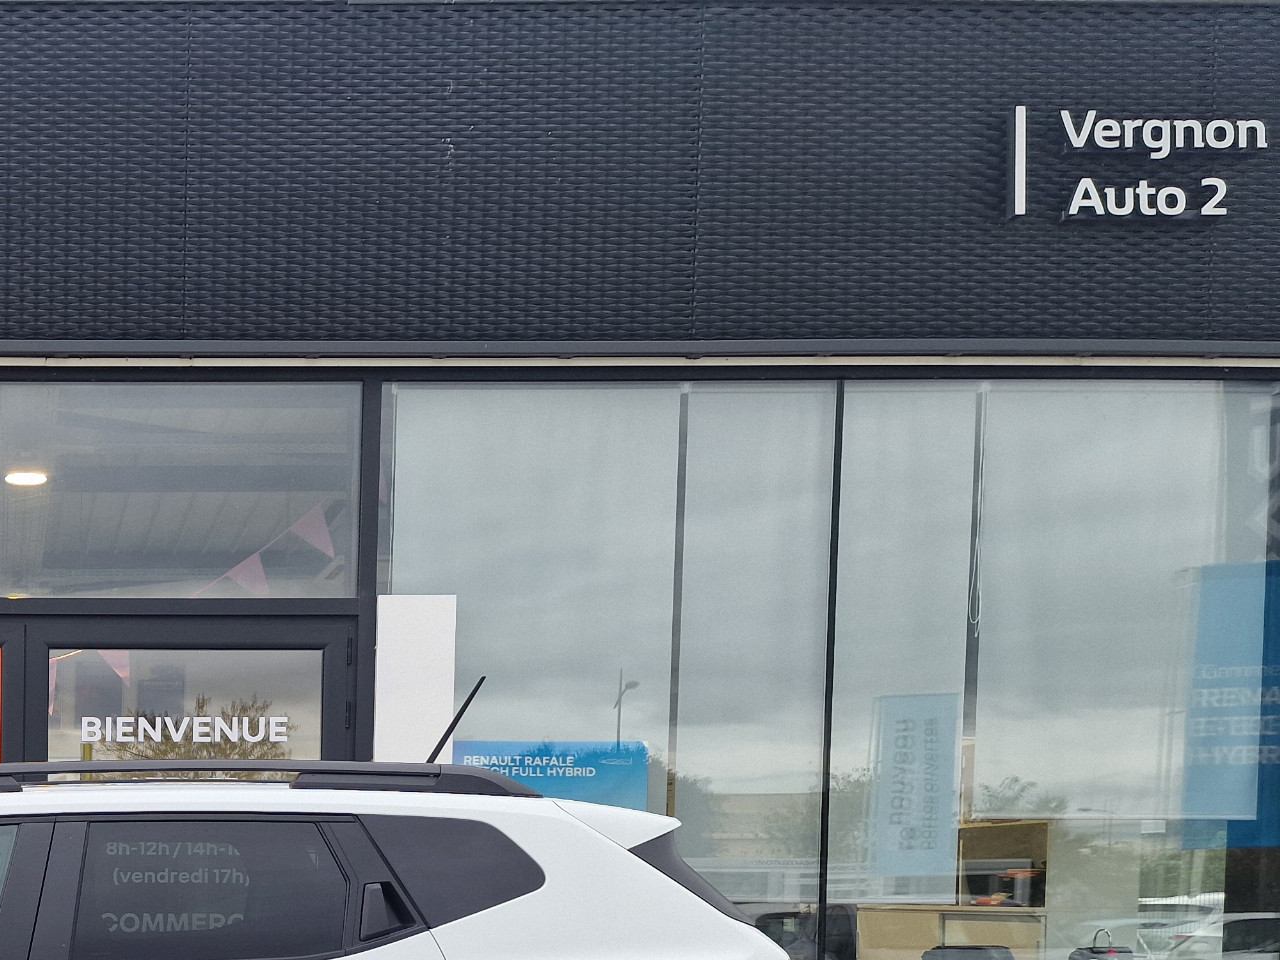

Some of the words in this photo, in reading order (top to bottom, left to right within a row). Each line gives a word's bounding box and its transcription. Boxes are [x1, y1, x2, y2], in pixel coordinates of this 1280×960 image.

[1060, 110, 1268, 160] Vergnon
[1069, 177, 1186, 216] Auto
[1200, 177, 1227, 216] 2
[81, 716, 288, 743] BIENVENUE
[463, 755, 522, 766] RENAULT
[524, 756, 574, 767] RAFALE
[512, 767, 544, 777] FULL
[547, 767, 596, 777] HYBRID
[106, 842, 169, 856] 8h-12h
[113, 868, 209, 885] (vendredi
